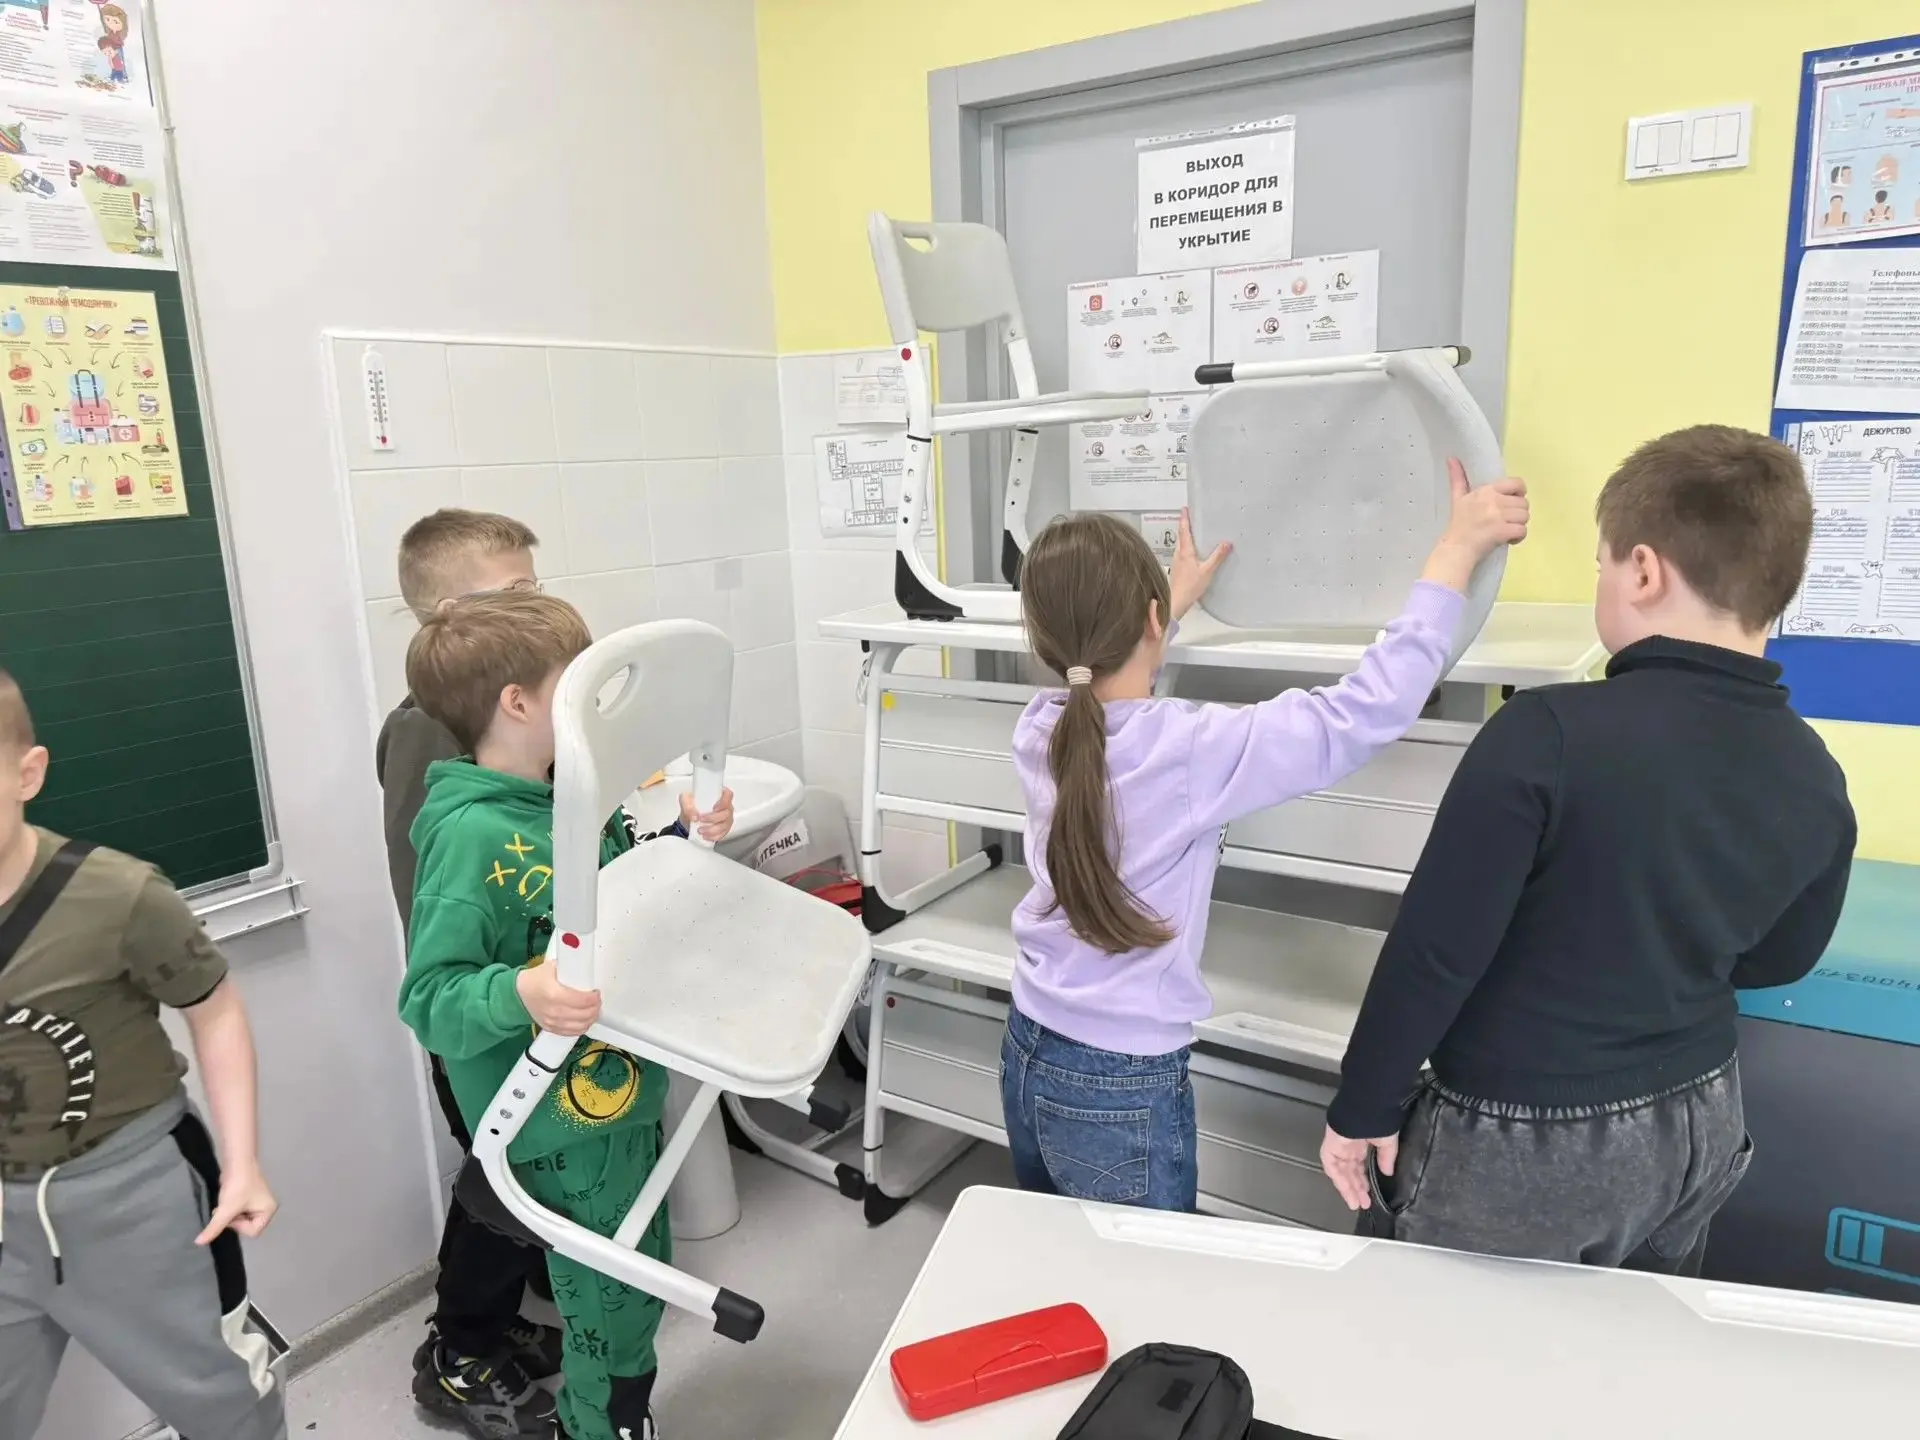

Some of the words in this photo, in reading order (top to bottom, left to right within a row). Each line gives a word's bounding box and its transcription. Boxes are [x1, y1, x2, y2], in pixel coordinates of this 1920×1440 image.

[1186, 153, 1244, 174] ВЫХОД
[1154, 192, 1164, 205] В
[1168, 180, 1240, 202] КОРИДОР
[1244, 175, 1279, 194] ДЛЯ
[1149, 202, 1268, 229] ПЕРЕМЕЩЕНИЯ
[1272, 200, 1283, 213] В
[1178, 229, 1251, 249] УКРЫТИЕ
[1863, 427, 1912, 437] ДЕЖУРСТВО
